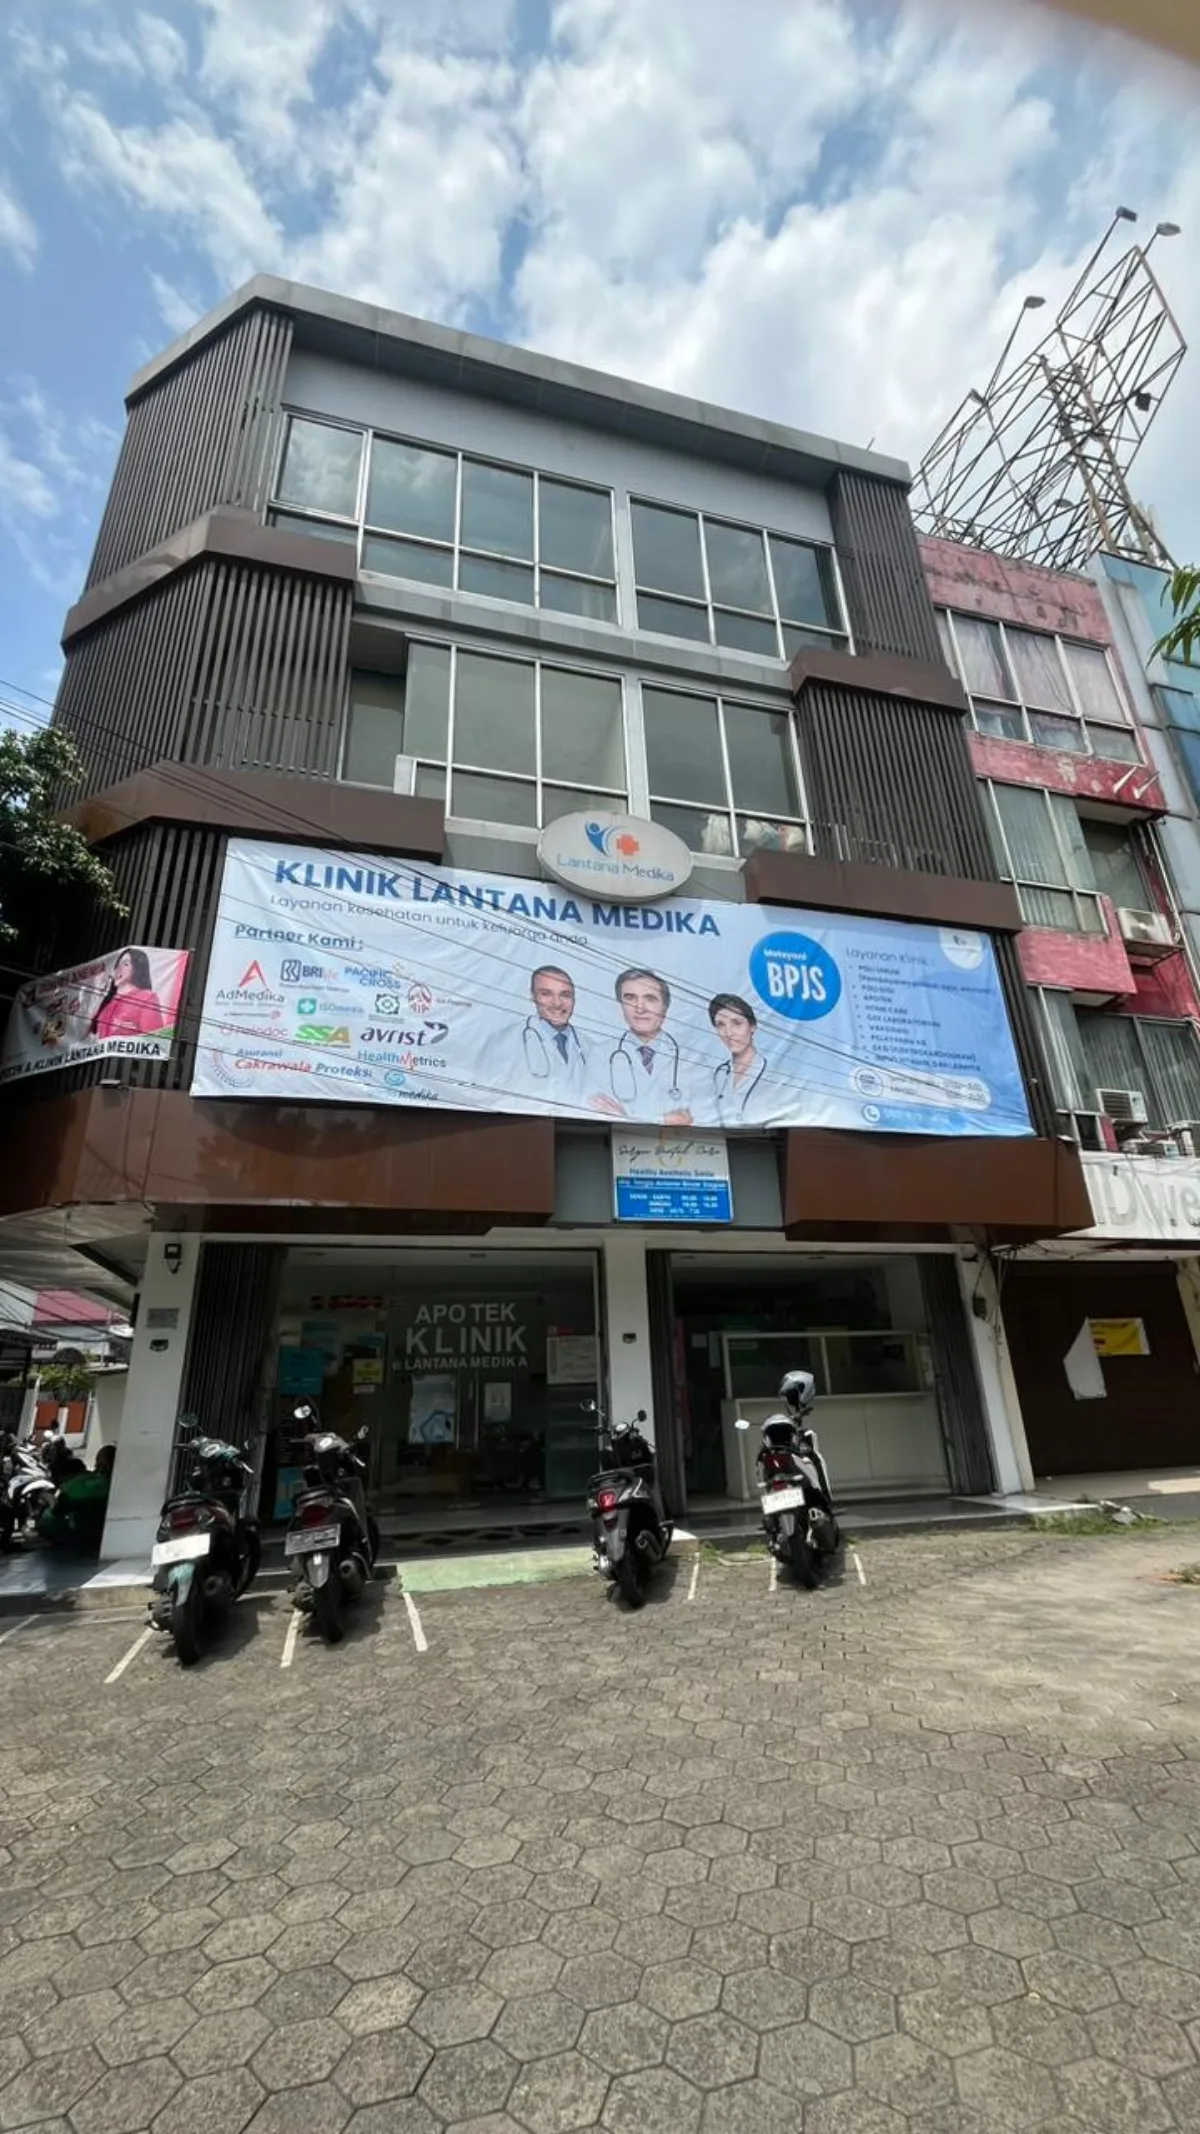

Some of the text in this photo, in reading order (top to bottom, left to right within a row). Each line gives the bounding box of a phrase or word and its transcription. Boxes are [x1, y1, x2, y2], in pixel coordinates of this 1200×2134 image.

[556, 853, 674, 882] Lantana Medika
[275, 860, 721, 937] KLINIK LANTANA MEDIKA
[270, 895, 343, 913] Layanan
[347, 903, 433, 924] kesehatan
[436, 914, 481, 931] untuk
[234, 924, 304, 941] Partner
[308, 931, 355, 948] Kami
[845, 946, 898, 961] Layanan
[303, 965, 322, 978] BRI
[767, 961, 827, 1001] BPJS
[360, 979, 401, 990] CROSS
[216, 988, 285, 1003] AdMedika
[108, 1040, 161, 1056] MEDIKA
[235, 1059, 373, 1078] Cakrawala Proteksi
[357, 1050, 447, 1070] HealthMetrics
[415, 1302, 516, 1325] APOTEK
[405, 1325, 528, 1355] KLINIK
[404, 1356, 468, 1371] LANTANA
[470, 1354, 529, 1369] MEDIKA
